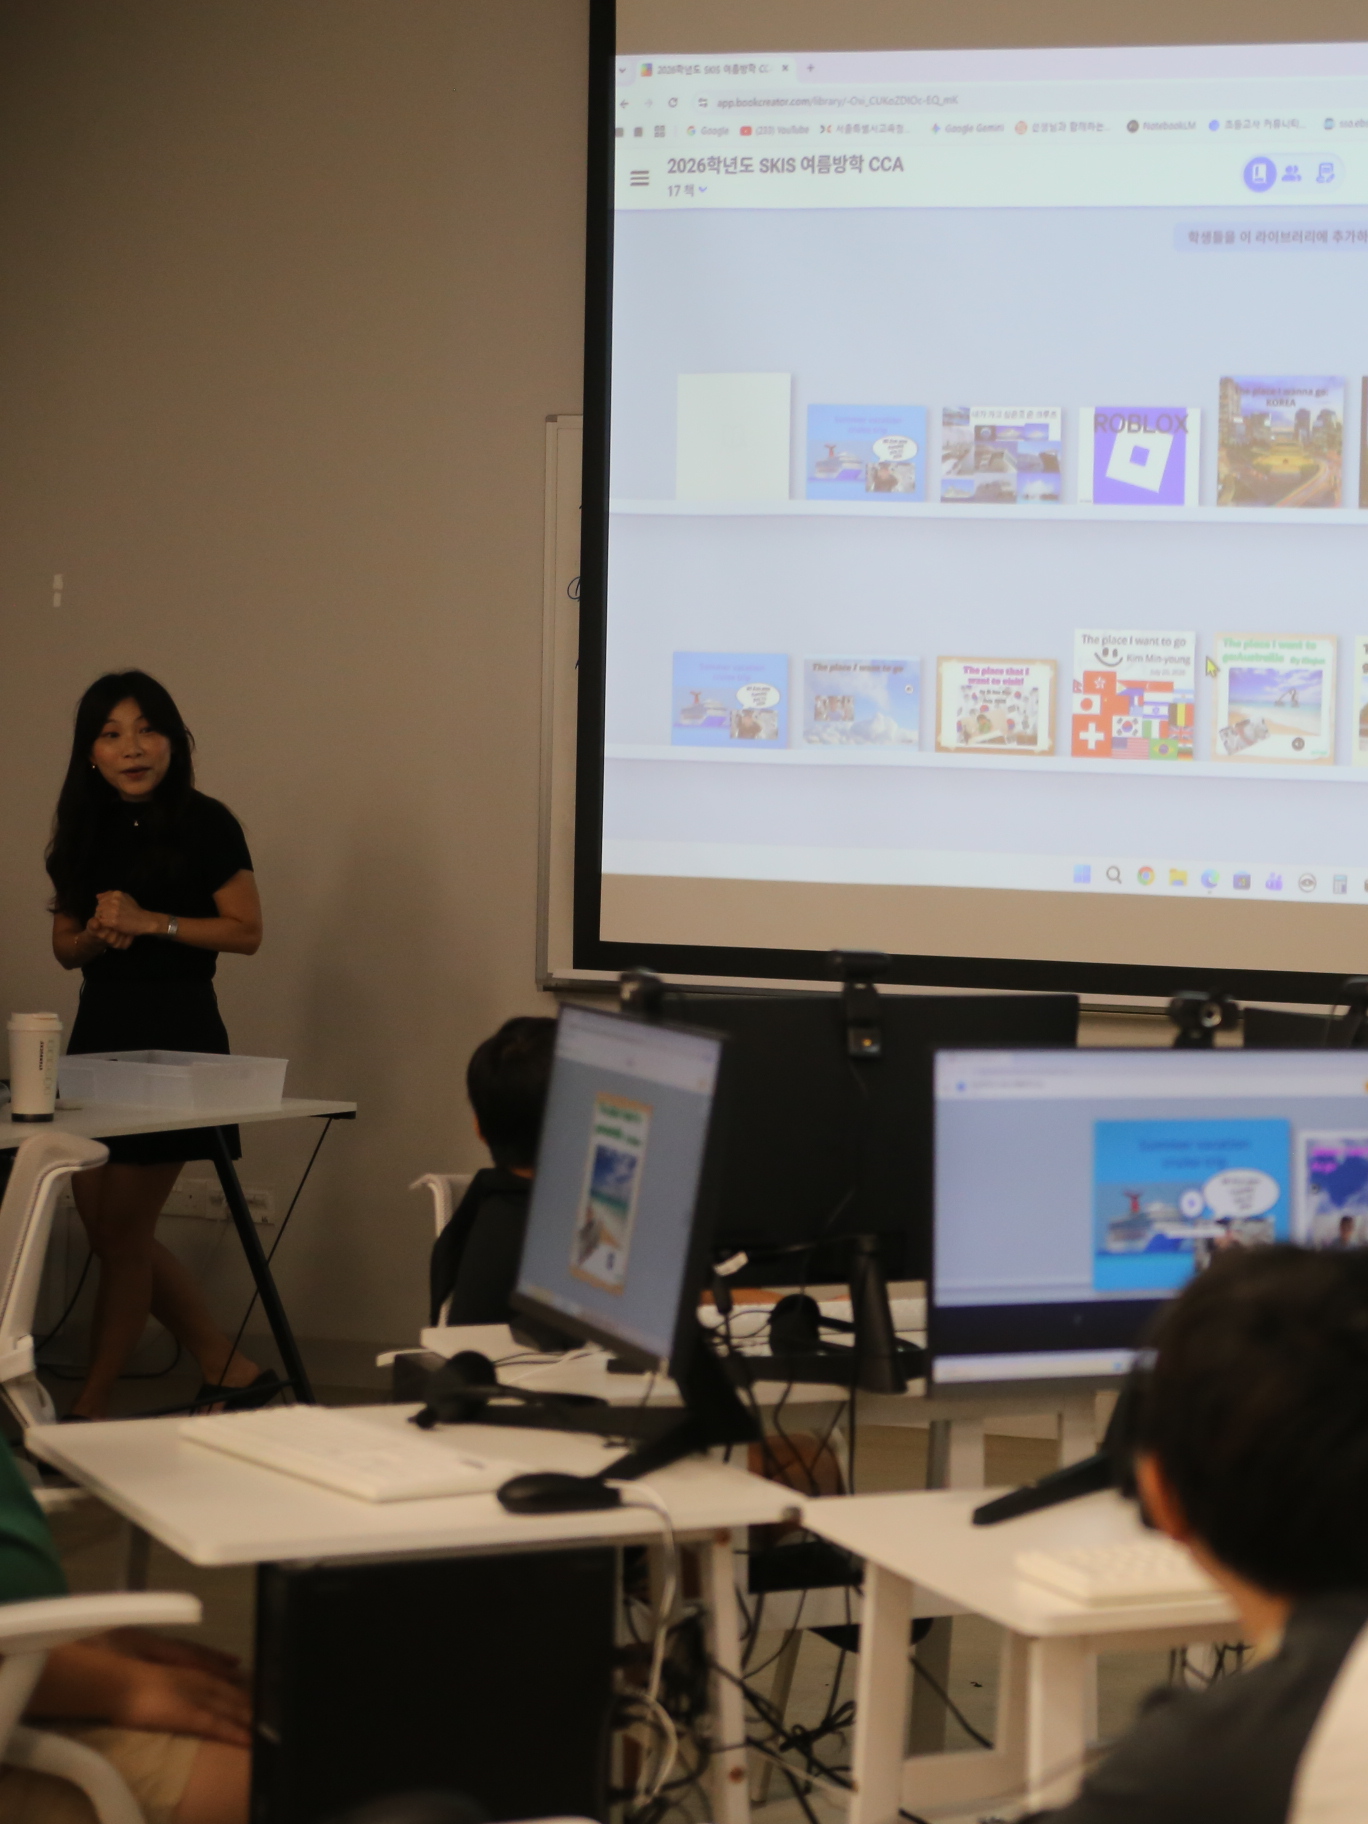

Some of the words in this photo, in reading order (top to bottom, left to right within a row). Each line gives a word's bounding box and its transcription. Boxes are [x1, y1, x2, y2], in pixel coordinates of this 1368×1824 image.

[700, 126, 729, 137] Google
[777, 125, 809, 136] YouTube
[945, 124, 974, 136] Google
[976, 122, 1005, 134] Gemini
[1142, 120, 1197, 131] NotebookLM
[667, 155, 755, 175] 2026학년도
[758, 156, 797, 174] SKIS
[800, 154, 864, 175] 여름방학
[868, 155, 904, 174] CCA
[667, 184, 682, 198] 17
[683, 183, 695, 198] 책
[1239, 229, 1252, 245] 이
[1254, 228, 1329, 245] 라이브러리에
[1093, 412, 1189, 434] ROBLOX
[1081, 633, 1101, 645] The
[1101, 633, 1128, 648] place
[1128, 635, 1133, 646] I
[1134, 635, 1160, 646] want
[1161, 636, 1172, 647] to
[1173, 638, 1187, 650] go
[1222, 637, 1242, 648] The
[1243, 638, 1271, 650] place
[1126, 653, 1145, 663] Kim
[1145, 653, 1191, 667] Min-young
[812, 662, 829, 673] The
[828, 662, 852, 674] place
[859, 663, 881, 673] want
[882, 664, 892, 673] to
[892, 665, 905, 675] go
[963, 665, 981, 675] The
[981, 666, 1005, 677] place
